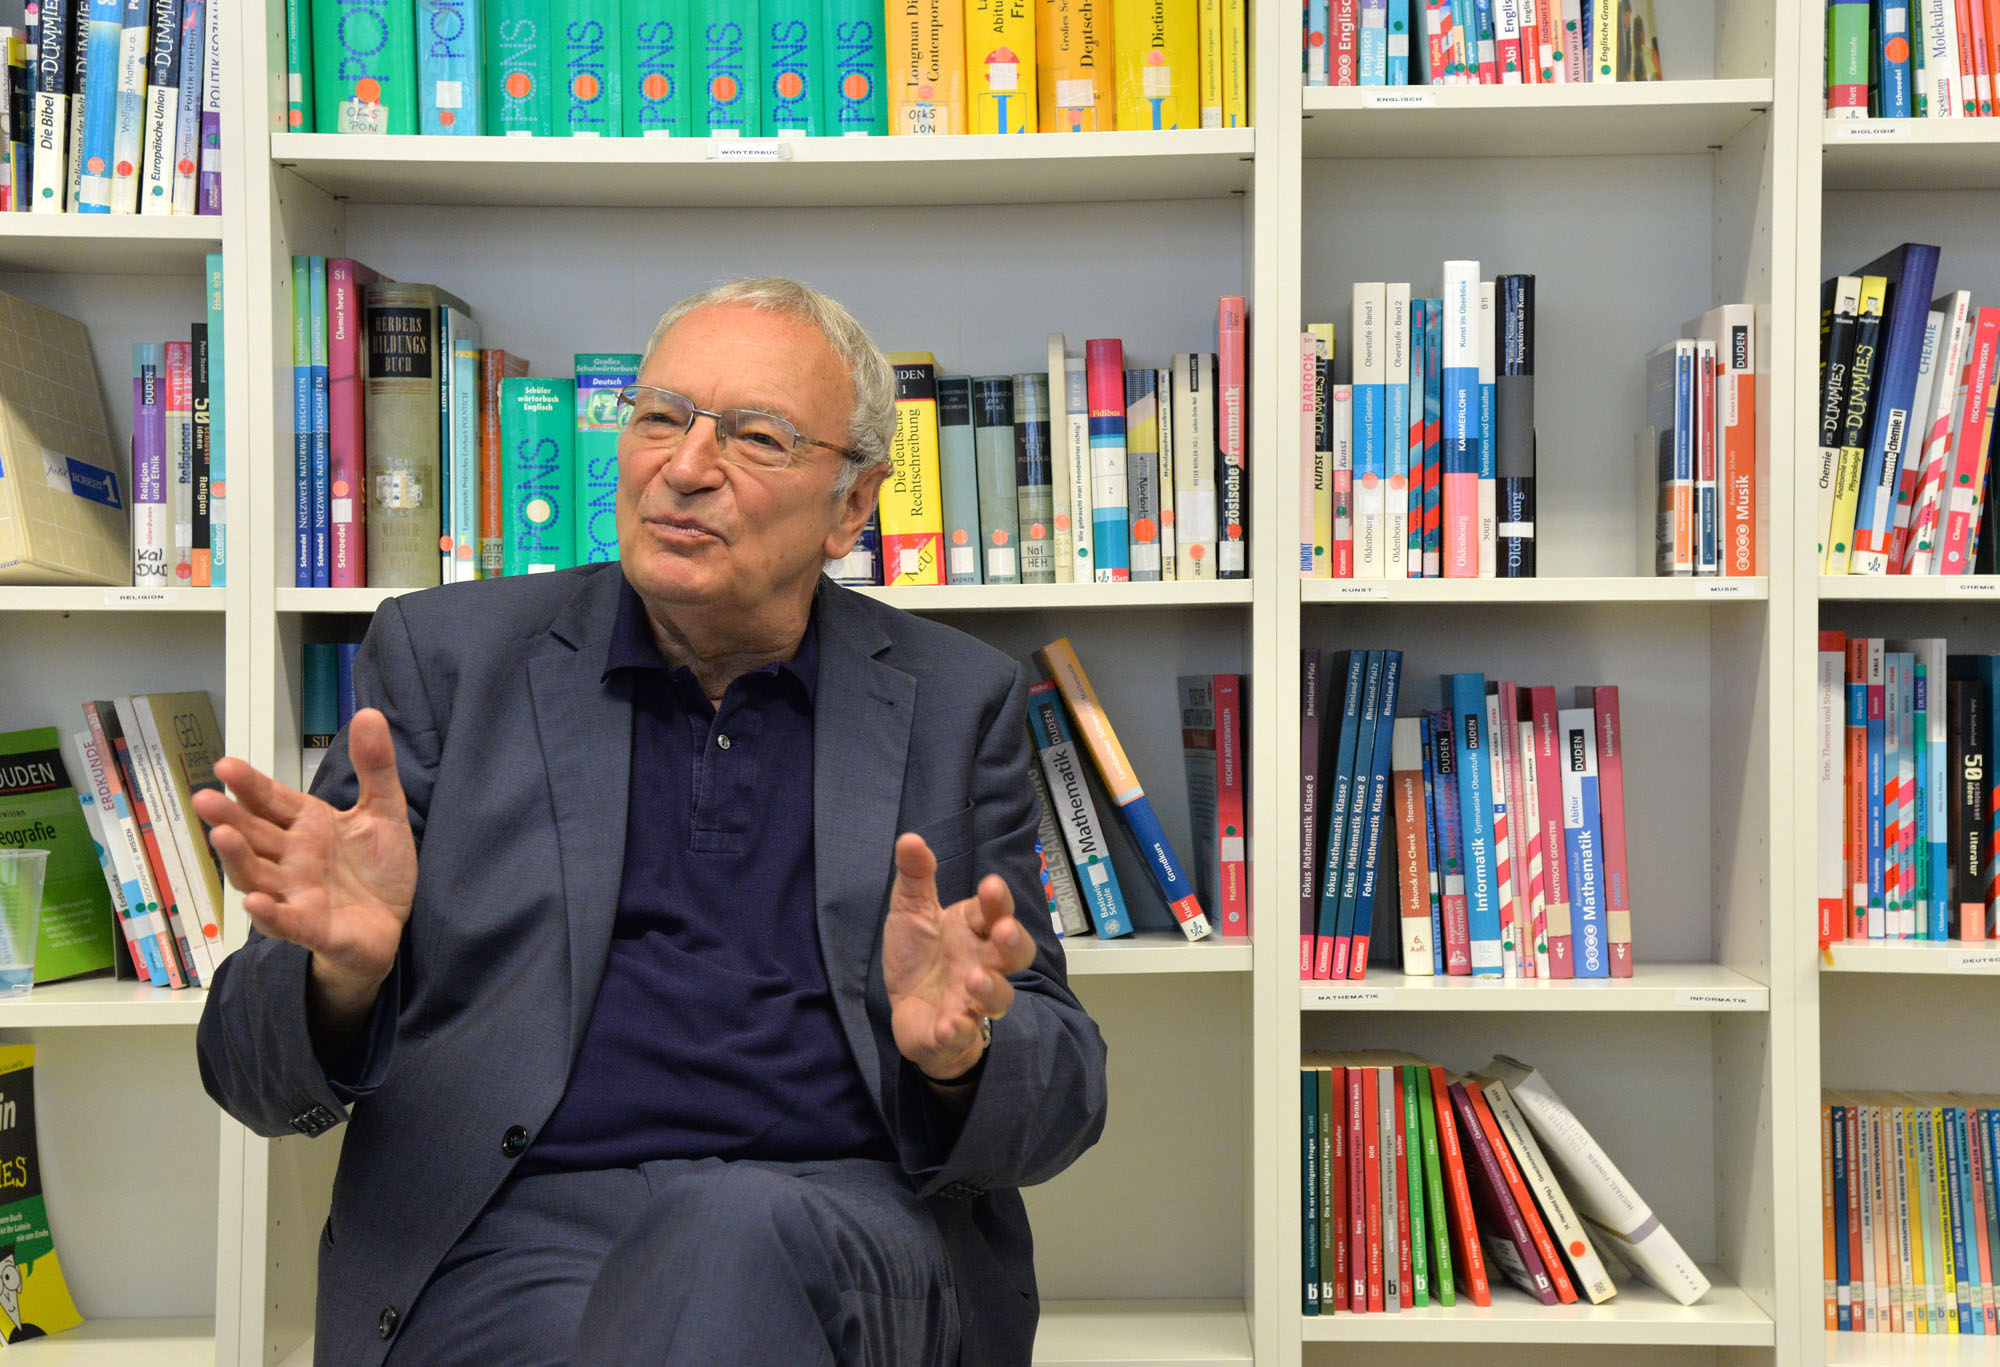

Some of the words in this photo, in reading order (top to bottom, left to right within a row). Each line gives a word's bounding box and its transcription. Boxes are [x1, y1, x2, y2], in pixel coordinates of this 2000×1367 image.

[188, 28, 196, 73] erleben
[907, 27, 924, 87] Longman
[1375, 42, 1386, 77] Abitur
[1505, 46, 1517, 65] Abi
[1600, 25, 1610, 63] Englische
[127, 55, 136, 86] Mattes
[500, 19, 537, 122] PONS
[567, 20, 605, 123] PONS
[637, 20, 675, 124] PONS
[706, 21, 744, 124] PONS
[772, 20, 808, 123] PONS
[837, 20, 875, 123] PONS
[1895, 69, 1903, 106] Schroedel
[42, 95, 54, 127] Bibel
[121, 88, 136, 133] Wolfgang
[155, 89, 166, 120] Union
[184, 75, 194, 112] Politik
[1848, 86, 1857, 105] Klett
[41, 128, 52, 150] Die
[912, 122, 936, 134] LON
[151, 121, 164, 181] Europäische
[335, 288, 345, 310] heute
[1365, 305, 1373, 325] Band
[1459, 280, 1467, 314] Überblick
[1517, 287, 1525, 308] Kunst
[1517, 309, 1525, 321] der
[335, 311, 345, 340] Chemie
[375, 316, 422, 333] HERDERS
[1394, 306, 1402, 327] Band
[372, 335, 426, 354] BILDUNGS
[1365, 330, 1373, 368] Oberstufe
[1394, 331, 1402, 368] Oberstufe
[1459, 327, 1467, 347] Kunst
[1516, 322, 1525, 364] Perspektiven
[1736, 331, 1746, 369] DUDEN
[1919, 323, 1937, 375] CHEMIE
[384, 356, 412, 372] BUCH
[592, 377, 622, 386] Deutsch
[1303, 352, 1314, 412] BAROCK
[145, 371, 155, 405] DUDEN
[517, 395, 559, 403] wörterbuch
[524, 387, 552, 395] Schüler
[1481, 386, 1490, 422] Gestalten
[1825, 362, 1846, 431] DUMMIES
[1846, 344, 1874, 429] DUMMIES
[194, 397, 210, 424] 50
[523, 403, 554, 412] Englisch
[1092, 409, 1121, 417] Fidibus
[1458, 389, 1467, 452] KAMMERLOHR
[893, 408, 904, 467] deutsche
[1074, 421, 1083, 446] richtig?
[1224, 387, 1240, 467] Grammatik
[1888, 418, 1901, 451] chemie
[910, 408, 923, 517] Rechtschreibung
[1075, 447, 1083, 484] Fremdwörter
[1314, 454, 1323, 490] Kunst
[1340, 440, 1348, 468] Kunst
[1481, 440, 1490, 477] Verstehen
[1819, 451, 1833, 489] Chemie
[1848, 451, 1861, 493] Physiologie
[140, 462, 151, 500] Religion
[197, 476, 208, 515] Religion
[517, 437, 560, 551] PONS
[894, 471, 907, 494] Die
[1736, 474, 1750, 520] Musik
[299, 482, 308, 529] Netzwerk
[316, 481, 325, 528] Netzwerk
[1077, 500, 1085, 529] gebraucht
[337, 524, 346, 568] Schroedel
[1364, 515, 1374, 564] Oldenbourg
[1392, 514, 1402, 563] Oldenbourg
[1458, 515, 1469, 567] Oldenbourg
[1027, 558, 1048, 568] HEH
[1301, 542, 1313, 572] DUMONT
[1112, 574, 1128, 583] Klett
[1365, 662, 1379, 721] Rheinland-Pfalz
[1822, 660, 1831, 705] Strukturen
[1047, 709, 1063, 745] DUDEN
[1469, 719, 1477, 749] DUDEN
[1822, 723, 1831, 758] Themen
[1442, 737, 1451, 774] DUDEN
[1471, 752, 1479, 790] Oberstufe
[1574, 735, 1584, 771] DUDEN
[1822, 758, 1831, 782] Texte,
[1964, 754, 1983, 780] 50
[83, 741, 115, 812] ERDKUNDE
[1966, 781, 1974, 806] ideen
[1053, 749, 1096, 854] Mathematik
[1304, 783, 1313, 812] Klasse
[1335, 783, 1347, 813] Klasse
[1353, 784, 1365, 813] Klasse
[1372, 783, 1384, 812] Klasse
[1405, 778, 1413, 823] Staatsrecht
[1473, 791, 1482, 835] Gymnasiale
[1570, 796, 1580, 825] Abitur
[126, 828, 138, 855] WISSEN
[1303, 815, 1313, 869] Mathematik
[1329, 815, 1344, 868] Mathematik
[1347, 816, 1362, 870] Mathematik
[1366, 814, 1380, 868] Mathematik
[1969, 831, 1979, 876] Literatur
[1153, 842, 1176, 882] Grundkurs
[1471, 837, 1489, 912] Informatik
[1578, 829, 1597, 921] Mathematik
[112, 874, 128, 909] Erdkunde
[1107, 887, 1118, 915] Schule
[1302, 870, 1311, 898] Fokus
[1326, 871, 1337, 898] Fokus
[1344, 871, 1355, 898] Fokus
[1362, 870, 1374, 897] Fokus
[1181, 900, 1194, 919] Klett
[1353, 1100, 1361, 1118] Dritte
[1353, 1119, 1361, 1131] Das
[1463, 1105, 1482, 1139] Christentum
[1307, 1138, 1316, 1159] Fragen
[1322, 1137, 1331, 1158] Fragen
[1335, 1125, 1343, 1157] Mittelalter
[1307, 1160, 1316, 1197] wichtigsten
[1322, 1159, 1331, 1195] wichtigsten
[1899, 1175, 1907, 1202] GROSSE
[1308, 1207, 1316, 1219] Die
[1323, 1206, 1331, 1218] Die
[1902, 1218, 1910, 1263] KONSTANTIN
